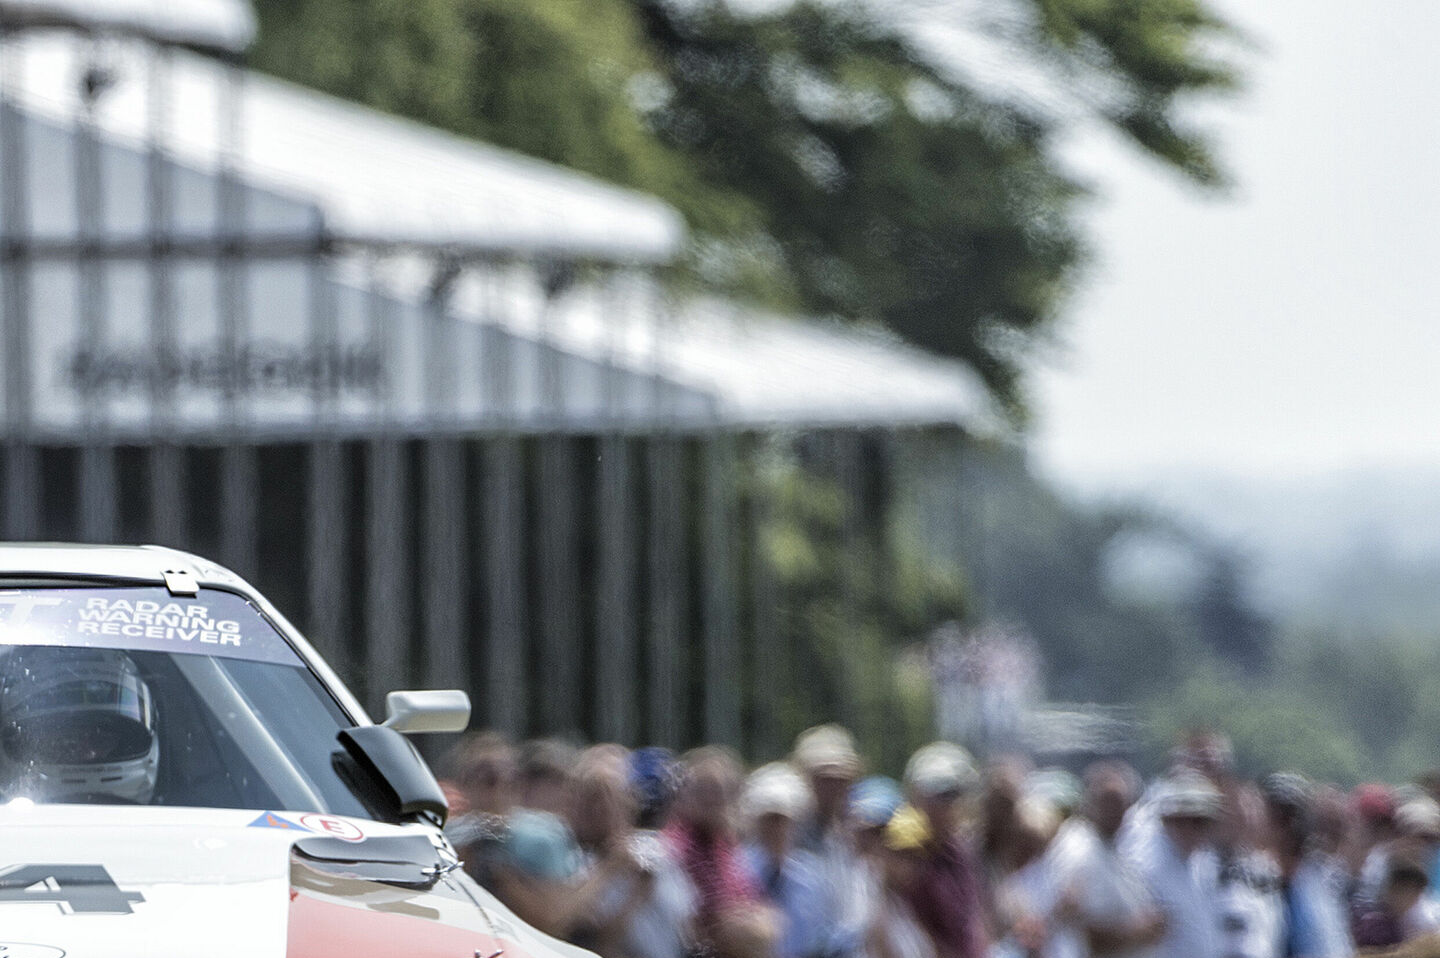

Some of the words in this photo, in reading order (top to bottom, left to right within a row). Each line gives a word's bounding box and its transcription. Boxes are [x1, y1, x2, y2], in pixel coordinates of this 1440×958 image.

[78, 608, 242, 634] WARNING
[85, 597, 209, 619] RADAR
[77, 620, 243, 647] RECEIVER
